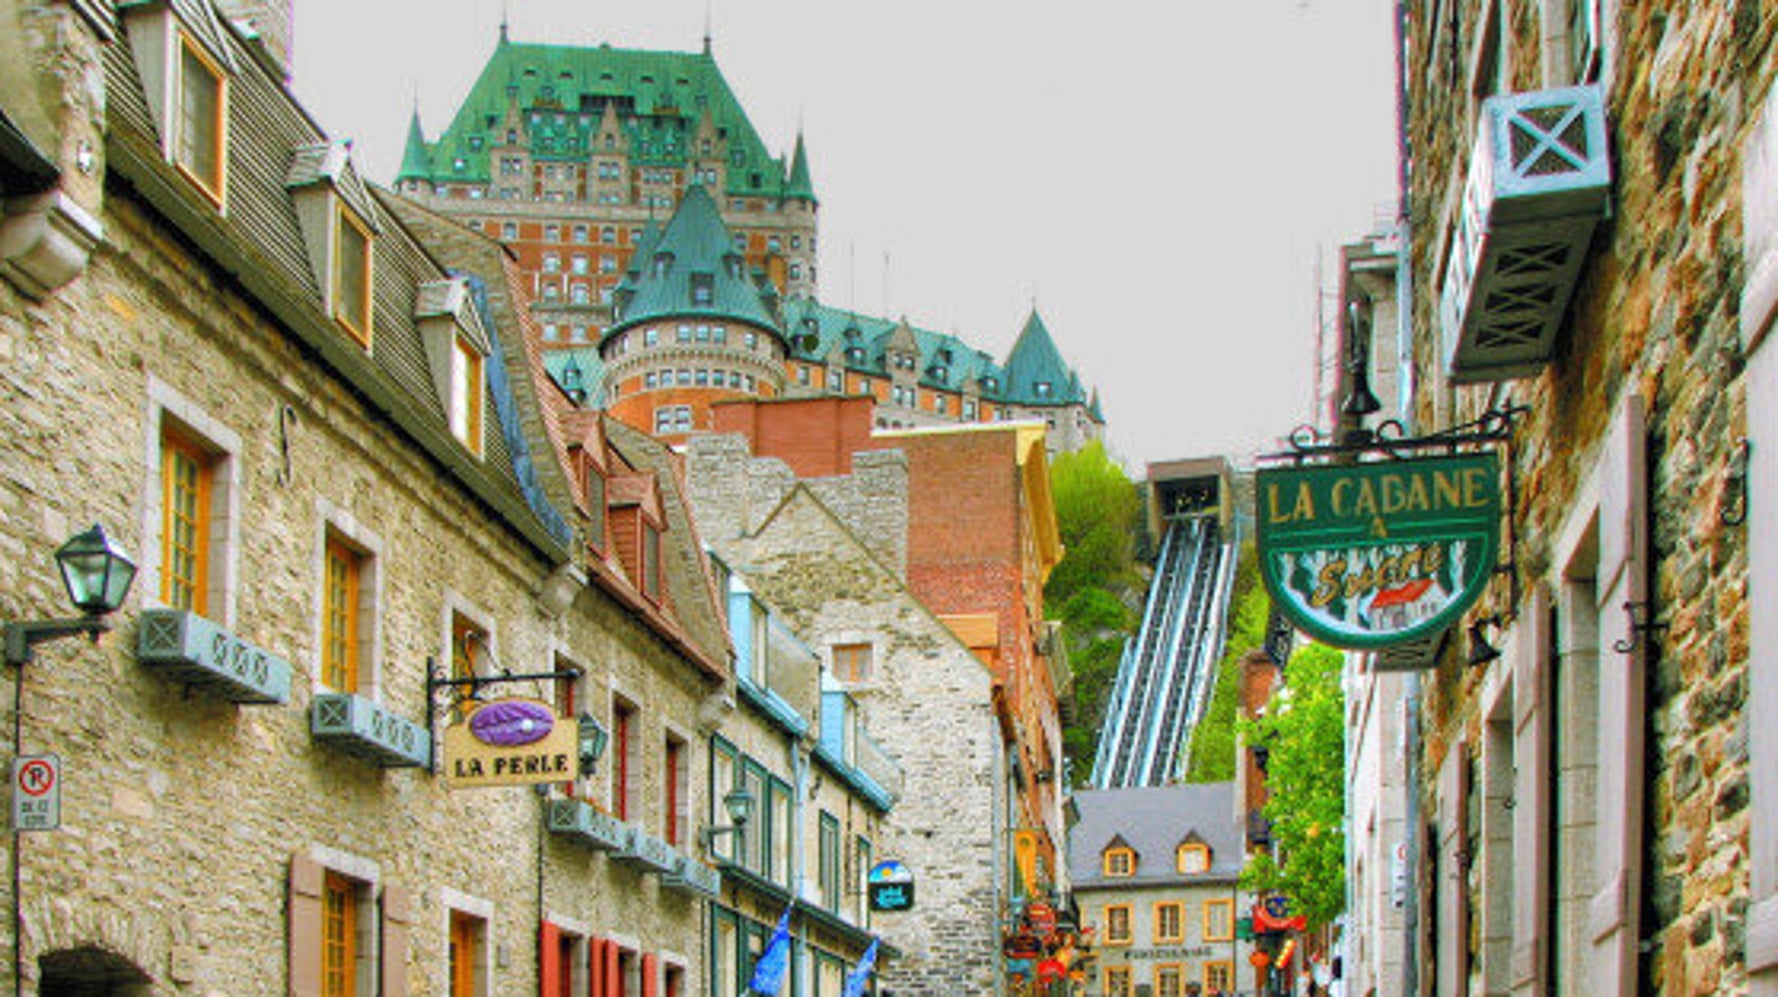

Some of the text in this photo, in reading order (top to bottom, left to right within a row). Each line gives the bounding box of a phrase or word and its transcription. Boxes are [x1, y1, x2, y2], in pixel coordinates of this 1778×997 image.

[1268, 468, 1490, 523] LA CABANE
[455, 754, 568, 777] LA PERLE
